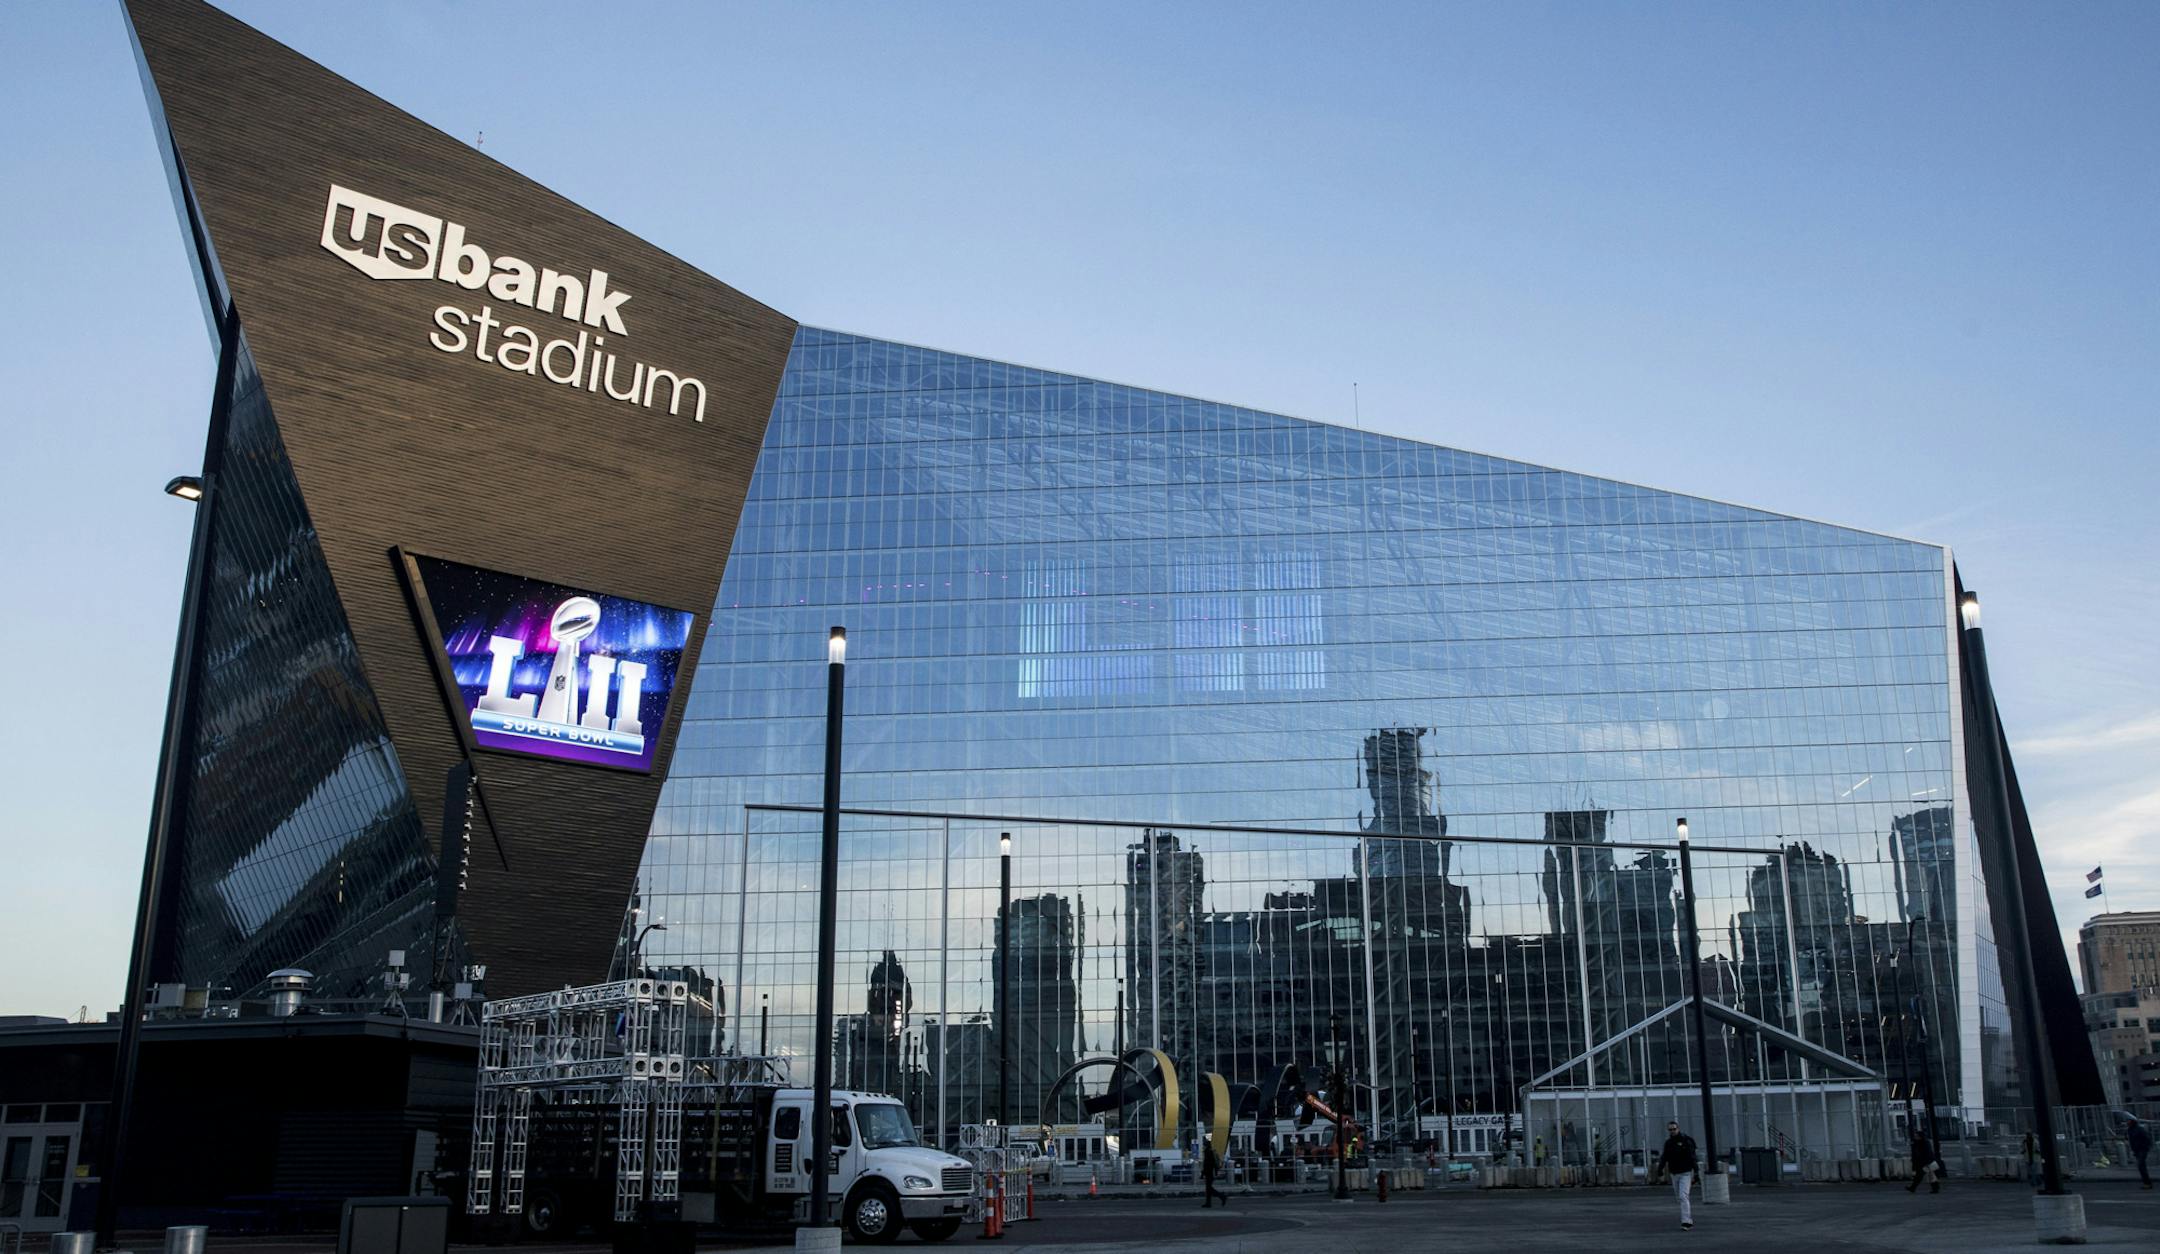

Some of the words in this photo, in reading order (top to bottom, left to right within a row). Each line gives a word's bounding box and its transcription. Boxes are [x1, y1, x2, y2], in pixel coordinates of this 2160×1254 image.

[429, 305, 708, 423] stadium
[502, 718, 561, 738] SUPER
[568, 728, 615, 747] BOWL
[1456, 1116, 1489, 1126] LEGACY
[1491, 1115, 1513, 1125] GAE
